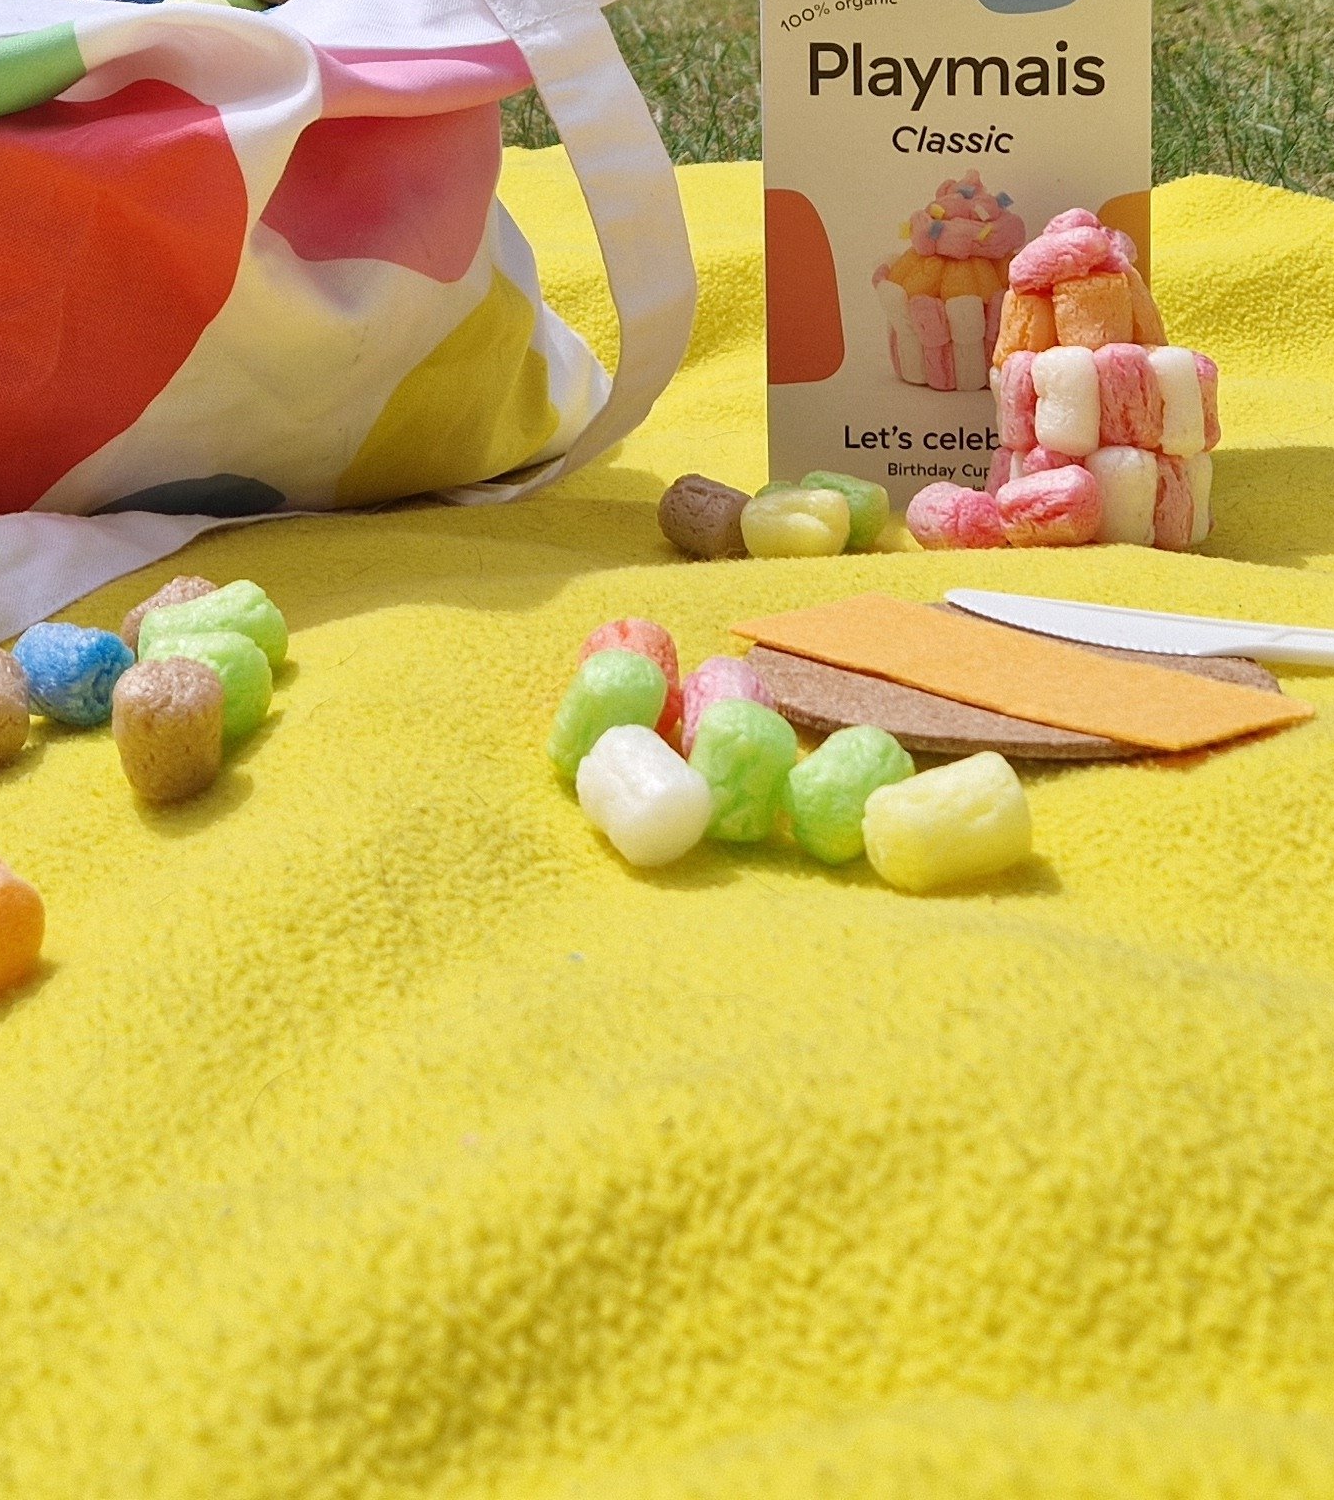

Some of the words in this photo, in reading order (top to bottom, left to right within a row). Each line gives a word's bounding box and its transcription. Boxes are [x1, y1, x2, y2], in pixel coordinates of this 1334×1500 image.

[780, 2, 830, 32] 100%
[809, 40, 1106, 111] Playmais
[892, 125, 1014, 154] Classic
[845, 425, 913, 449] Let’s
[888, 463, 957, 479] Birthday
